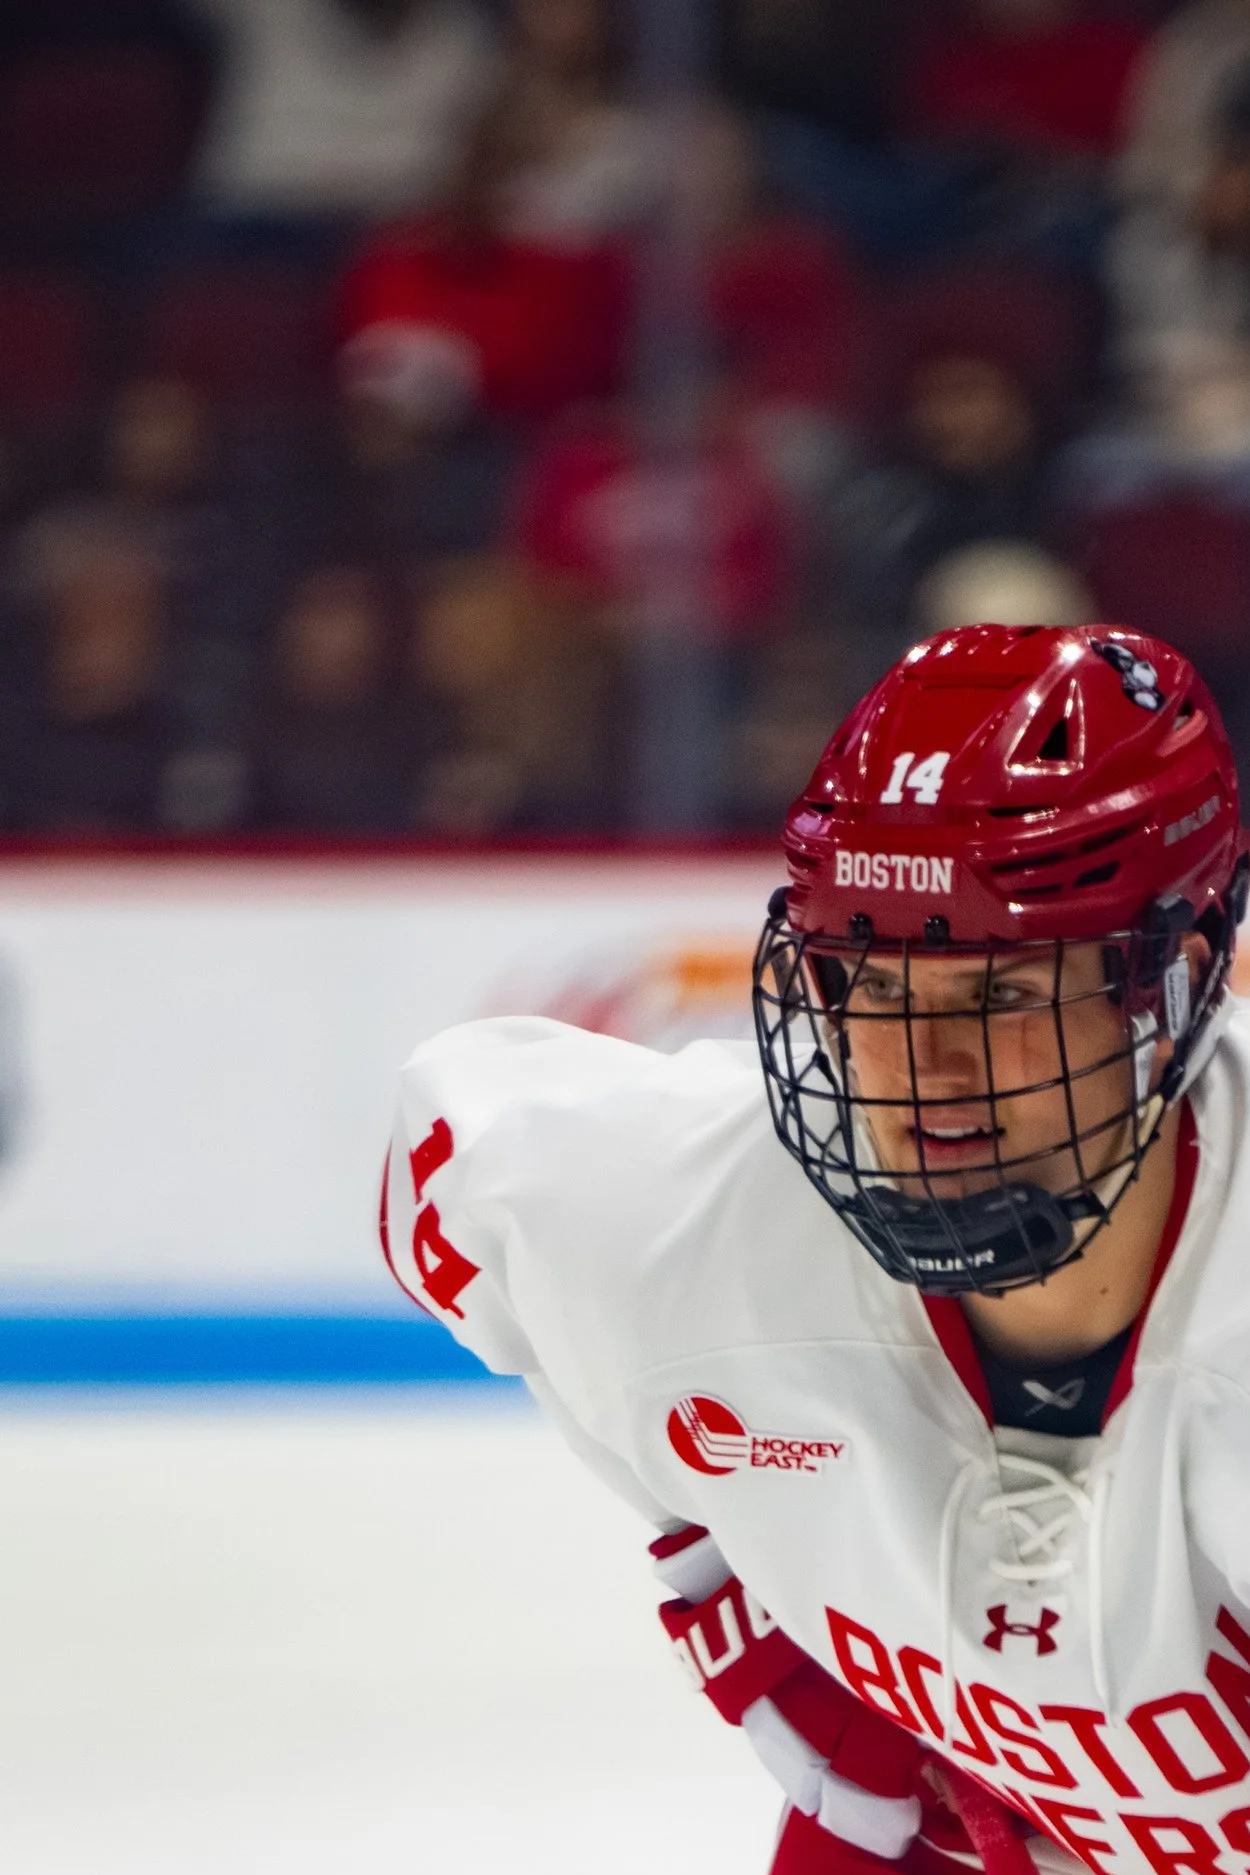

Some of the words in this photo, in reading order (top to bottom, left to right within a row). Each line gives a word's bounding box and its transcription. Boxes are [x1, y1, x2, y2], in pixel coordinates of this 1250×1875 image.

[880, 751, 951, 805] 14
[835, 851, 954, 894] BOSTON
[752, 1437, 844, 1458] HOCKEY
